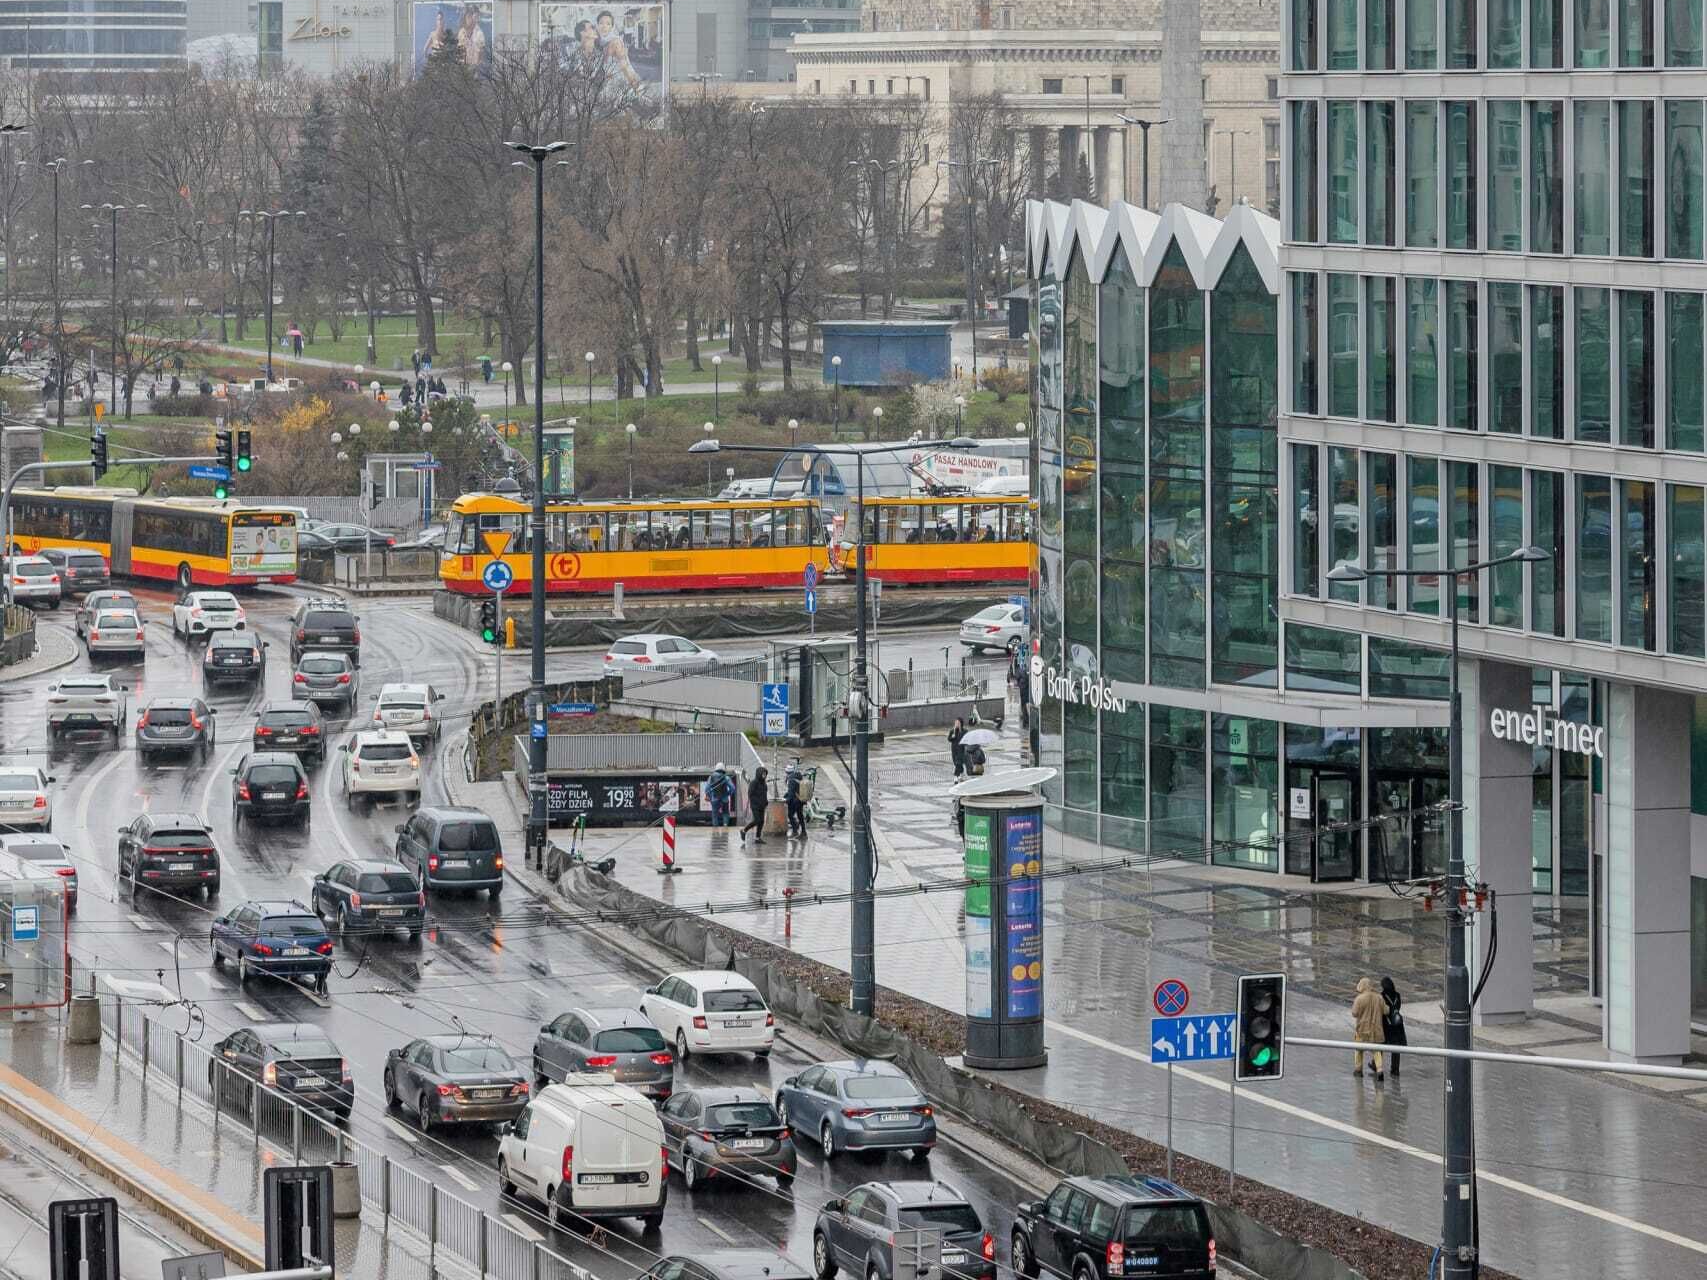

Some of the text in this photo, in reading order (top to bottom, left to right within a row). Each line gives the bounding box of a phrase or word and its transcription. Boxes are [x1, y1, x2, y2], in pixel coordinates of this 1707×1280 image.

[959, 457, 998, 471] HANDLOWY
[1047, 666, 1079, 704] Bank
[768, 719, 783, 728] WC
[569, 790, 588, 799] FILM
[569, 798, 593, 809] DZIEŃ
